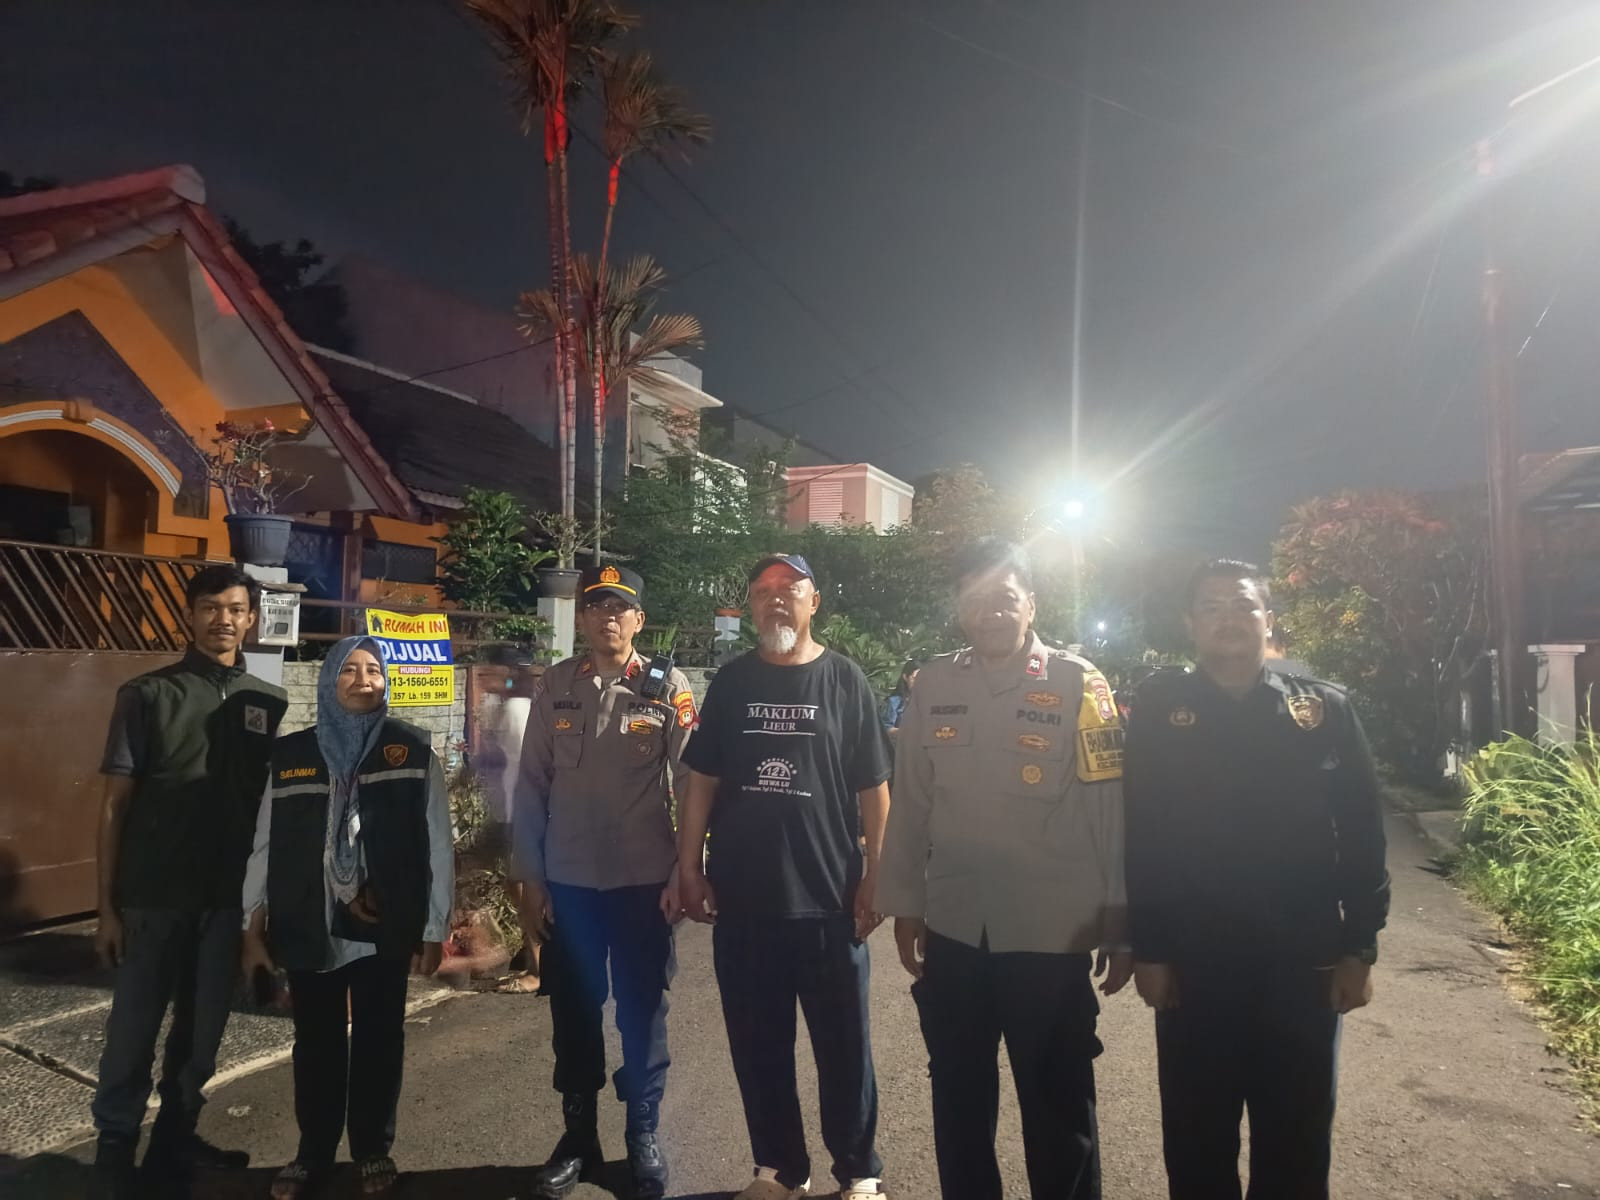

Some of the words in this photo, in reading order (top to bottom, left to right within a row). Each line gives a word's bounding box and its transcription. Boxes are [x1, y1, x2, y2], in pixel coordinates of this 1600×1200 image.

[384, 618, 425, 634] RUMAH
[429, 620, 447, 633] INI
[379, 641, 447, 662] DIJUAL
[747, 706, 816, 720] MAKLUM
[1017, 710, 1061, 726] POLRI
[762, 721, 796, 731] LIEUR
[766, 766, 786, 777] 123
